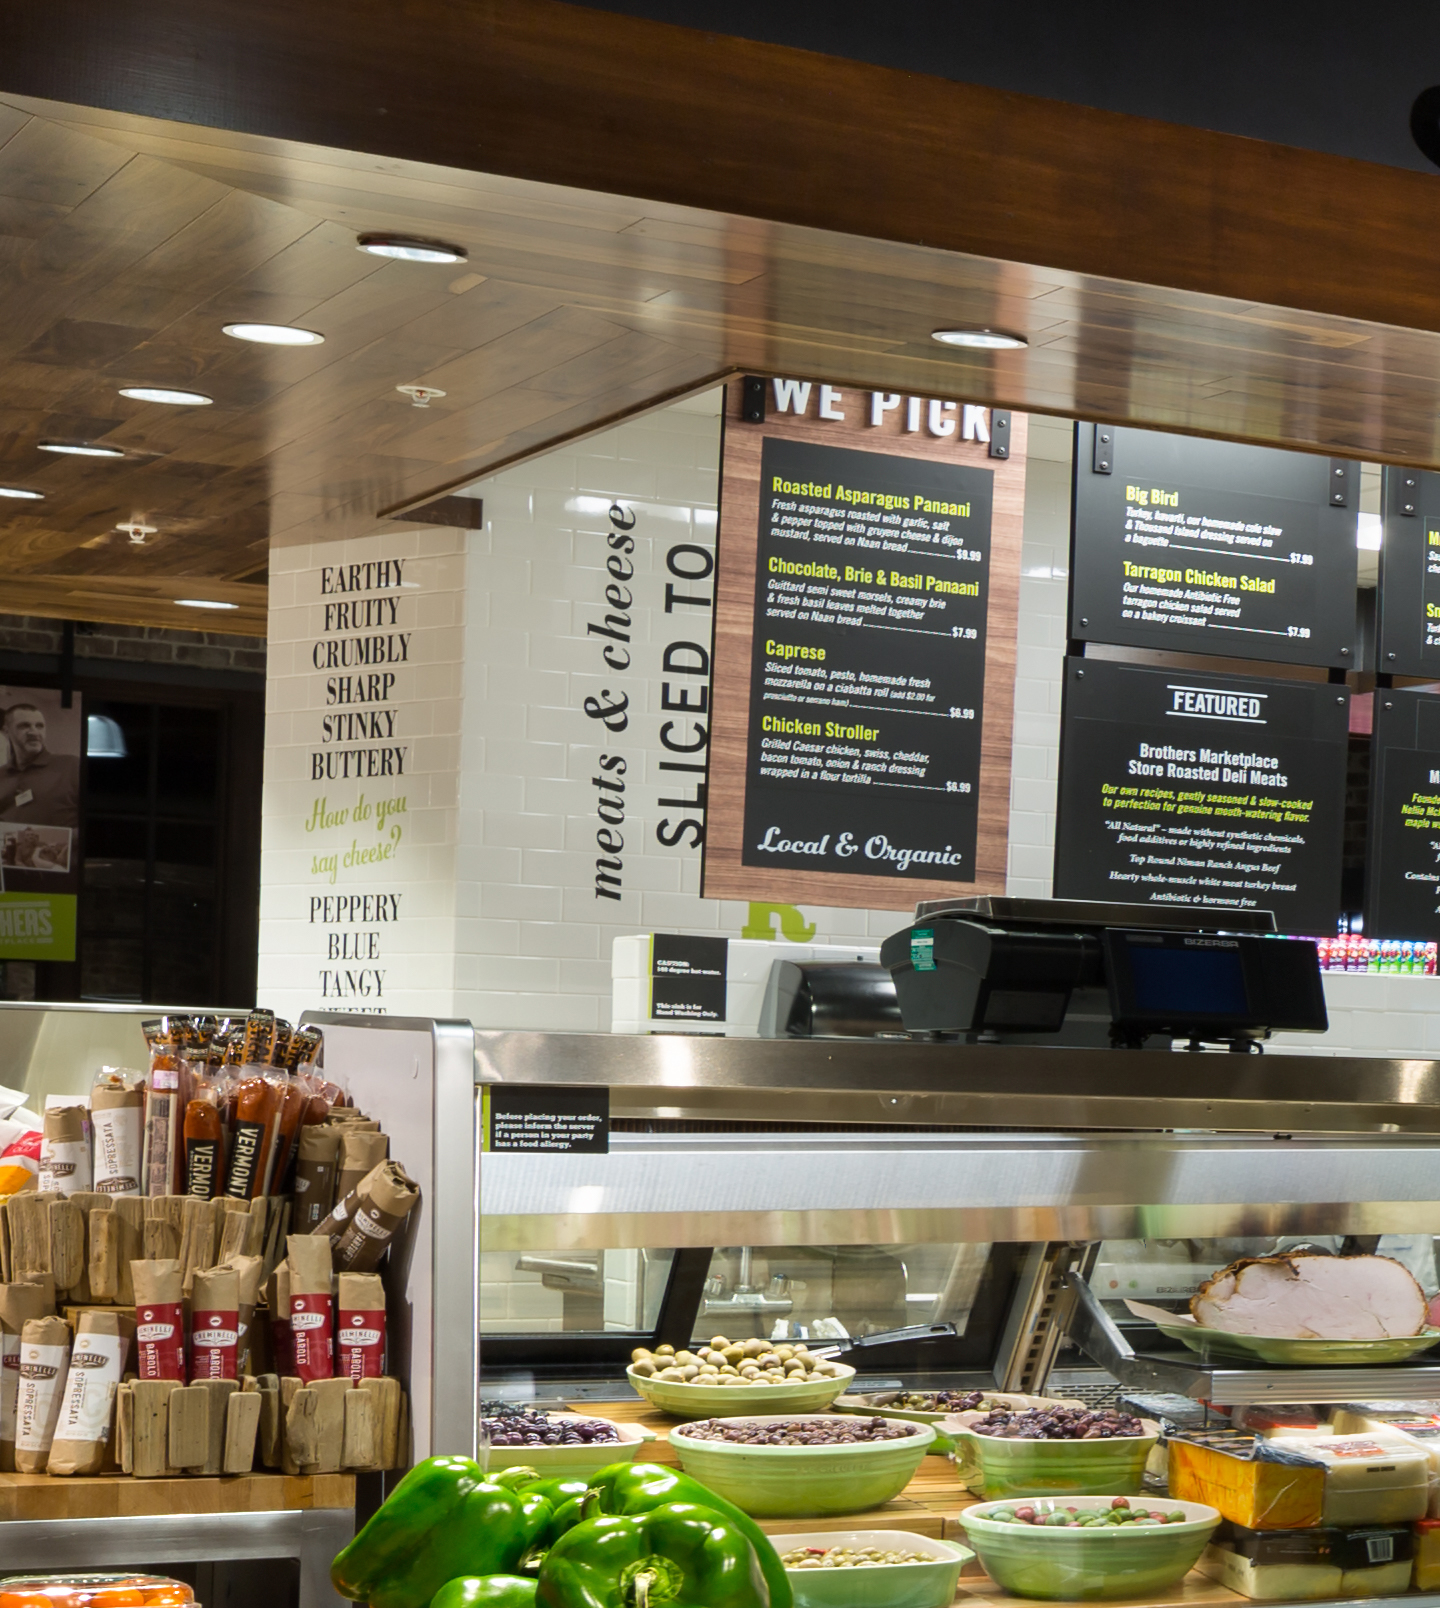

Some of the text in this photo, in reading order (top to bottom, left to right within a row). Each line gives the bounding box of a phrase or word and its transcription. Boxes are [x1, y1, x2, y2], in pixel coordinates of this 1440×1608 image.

[773, 378, 990, 443] WE PICK
[772, 476, 971, 518] Roasted Asparagus Panaani
[1125, 485, 1179, 507] Big Bird
[771, 498, 950, 532] Fresh asparagus roasted with garlic, salt
[770, 527, 981, 562] mustard, served on Naan bread $9.99
[321, 559, 406, 595] EARTHY
[768, 556, 979, 596] Chocolate, Brie & Basil Panaani
[1122, 560, 1275, 594] Tarragon Chicken Salad
[324, 597, 401, 631] FRUITY
[950, 626, 977, 639] $7.99
[313, 633, 411, 669] CRUMBLY
[765, 639, 826, 661] Caprese
[327, 673, 395, 705] SHARP
[584, 504, 636, 901] meats & cheese
[656, 543, 714, 850] SLICED TO
[1173, 690, 1260, 718] FEATURED
[322, 710, 398, 743] STINKY
[762, 715, 880, 741] Chicken Stroller
[311, 747, 408, 780] BUTTERY
[1128, 759, 1288, 787] Store Roasted Deli Meats
[1139, 742, 1279, 771] Brothers Marketplace
[306, 794, 407, 832] How do you
[311, 825, 402, 885] say cheese?
[757, 826, 962, 871] Local & Organic
[309, 894, 402, 923] PEPPERY
[328, 932, 380, 960] BLUE
[1183, 938, 1239, 948] BIZERBA
[319, 969, 387, 997] TANGY
[495, 1122, 522, 1130] please
[524, 1113, 555, 1122] placing
[578, 1114, 602, 1122] order,
[103, 1122, 119, 1174] SOPRESSATA
[226, 1127, 260, 1197] VERMONT
[540, 1141, 571, 1149] allergy.
[145, 1343, 157, 1377] BAROLO
[209, 1348, 221, 1379] BAROLO
[296, 1331, 306, 1365] BAROLO
[351, 1347, 362, 1379] BAROLO
[22, 1382, 36, 1436] SOPRESSATA
[68, 1371, 86, 1426] SOPRESSATA
